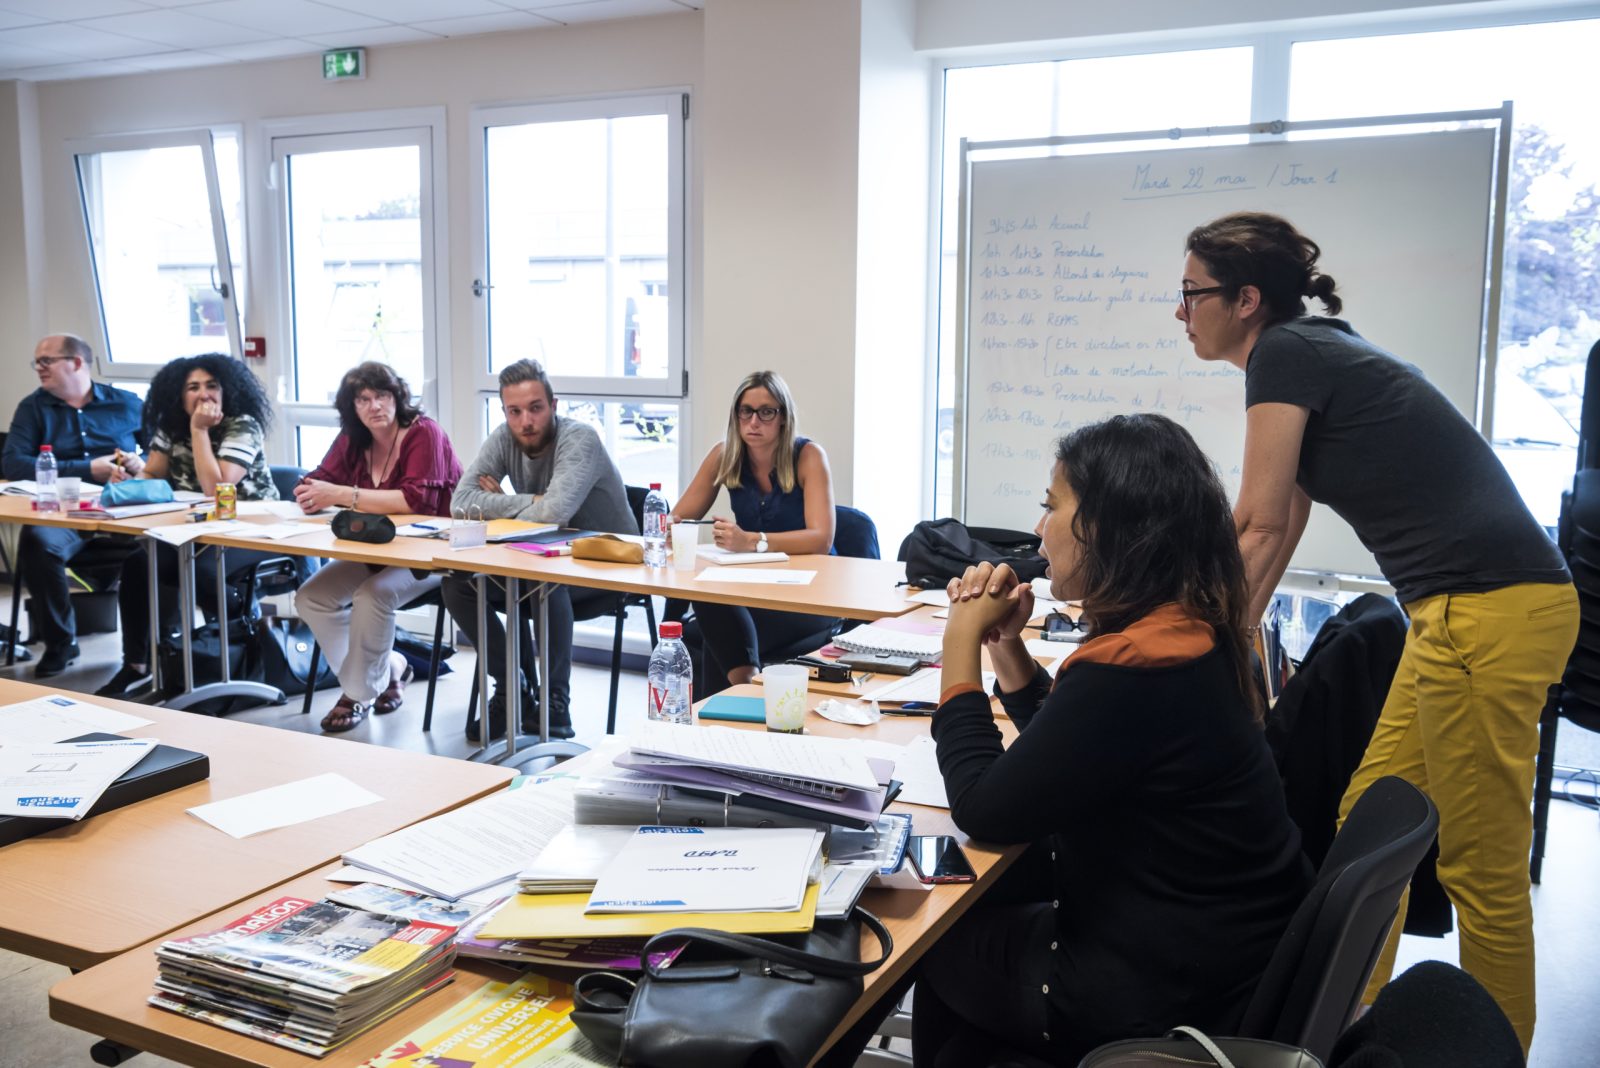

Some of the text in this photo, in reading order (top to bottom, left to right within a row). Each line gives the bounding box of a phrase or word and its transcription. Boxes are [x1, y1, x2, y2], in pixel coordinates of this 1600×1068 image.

[1183, 166, 1203, 188] 22
[1214, 174, 1246, 185] mai
[1281, 164, 1316, 187] Jour
[1325, 168, 1338, 184] 1
[1049, 212, 1090, 231] Accueil
[1053, 362, 1079, 376] Lettre
[1088, 366, 1101, 376] de
[1111, 362, 1170, 377] motivation
[1131, 392, 1142, 405] de
[427, 1023, 483, 1059] SERVICE
[480, 987, 534, 1024] CIVIQUE
[467, 995, 556, 1049] UNIVERSEL
